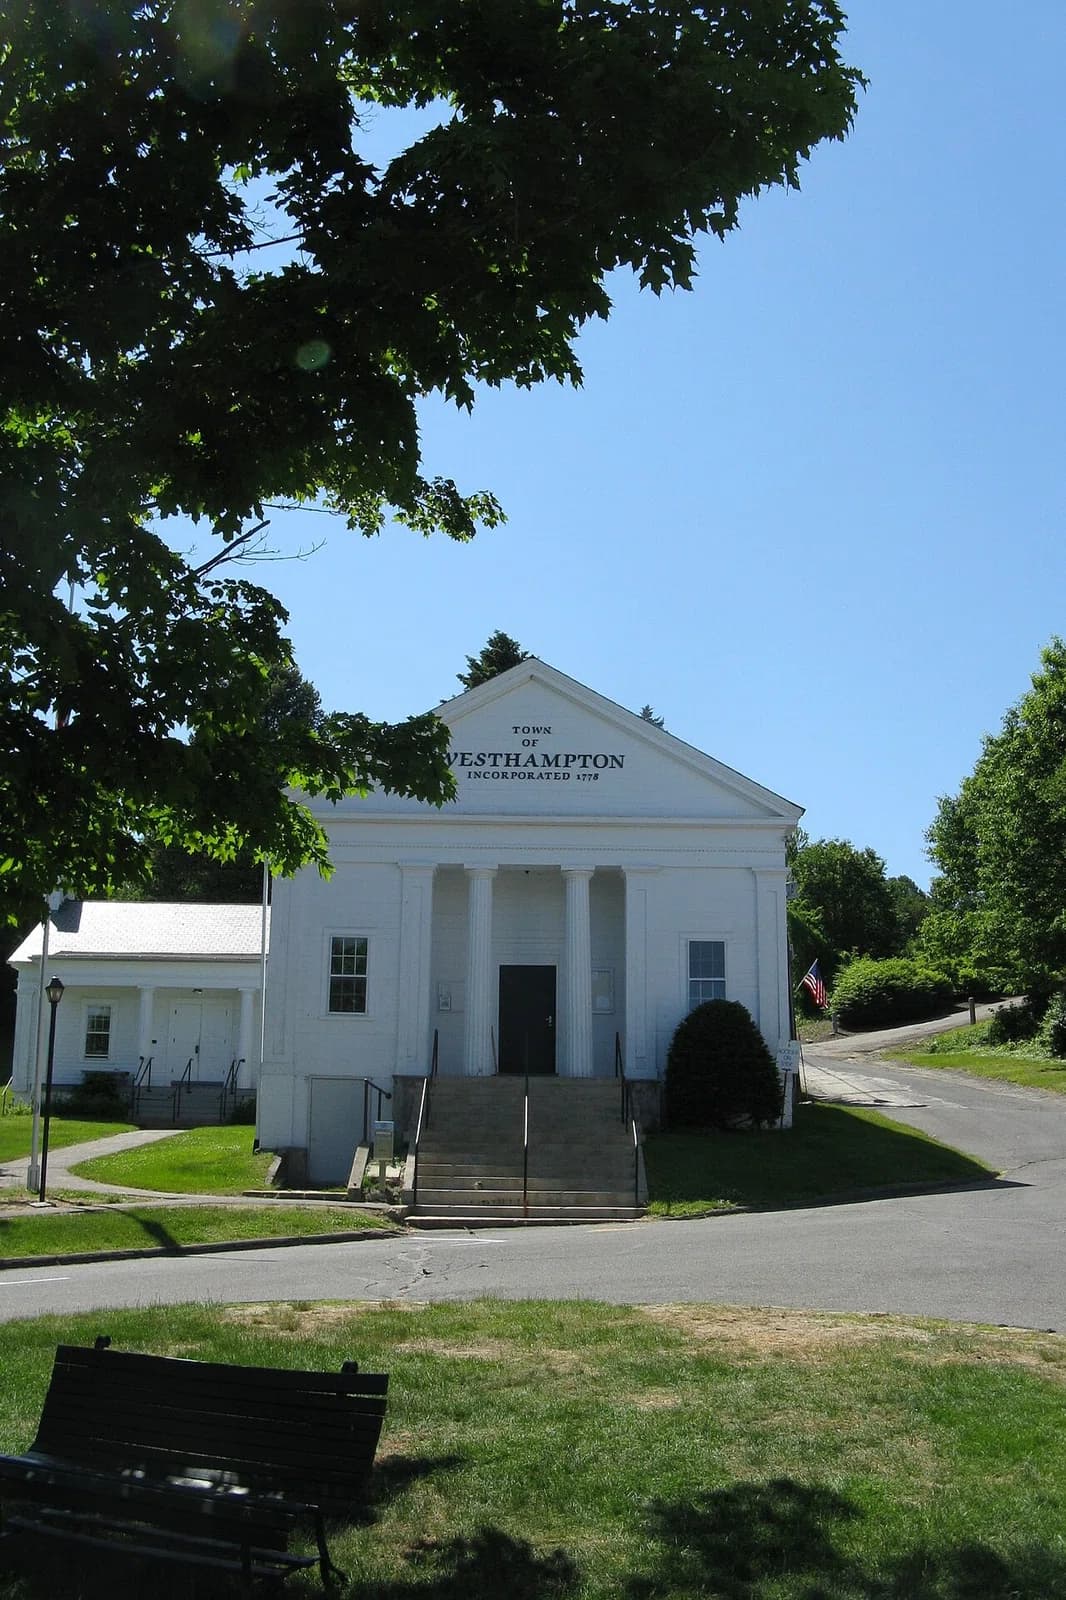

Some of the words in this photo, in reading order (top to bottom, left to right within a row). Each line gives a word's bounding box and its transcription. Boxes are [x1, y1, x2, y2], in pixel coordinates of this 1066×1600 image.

[512, 726, 552, 735] TOWN
[522, 738, 539, 747] OF
[467, 771, 570, 781] INCORPORATED
[576, 773, 600, 782] 1778
